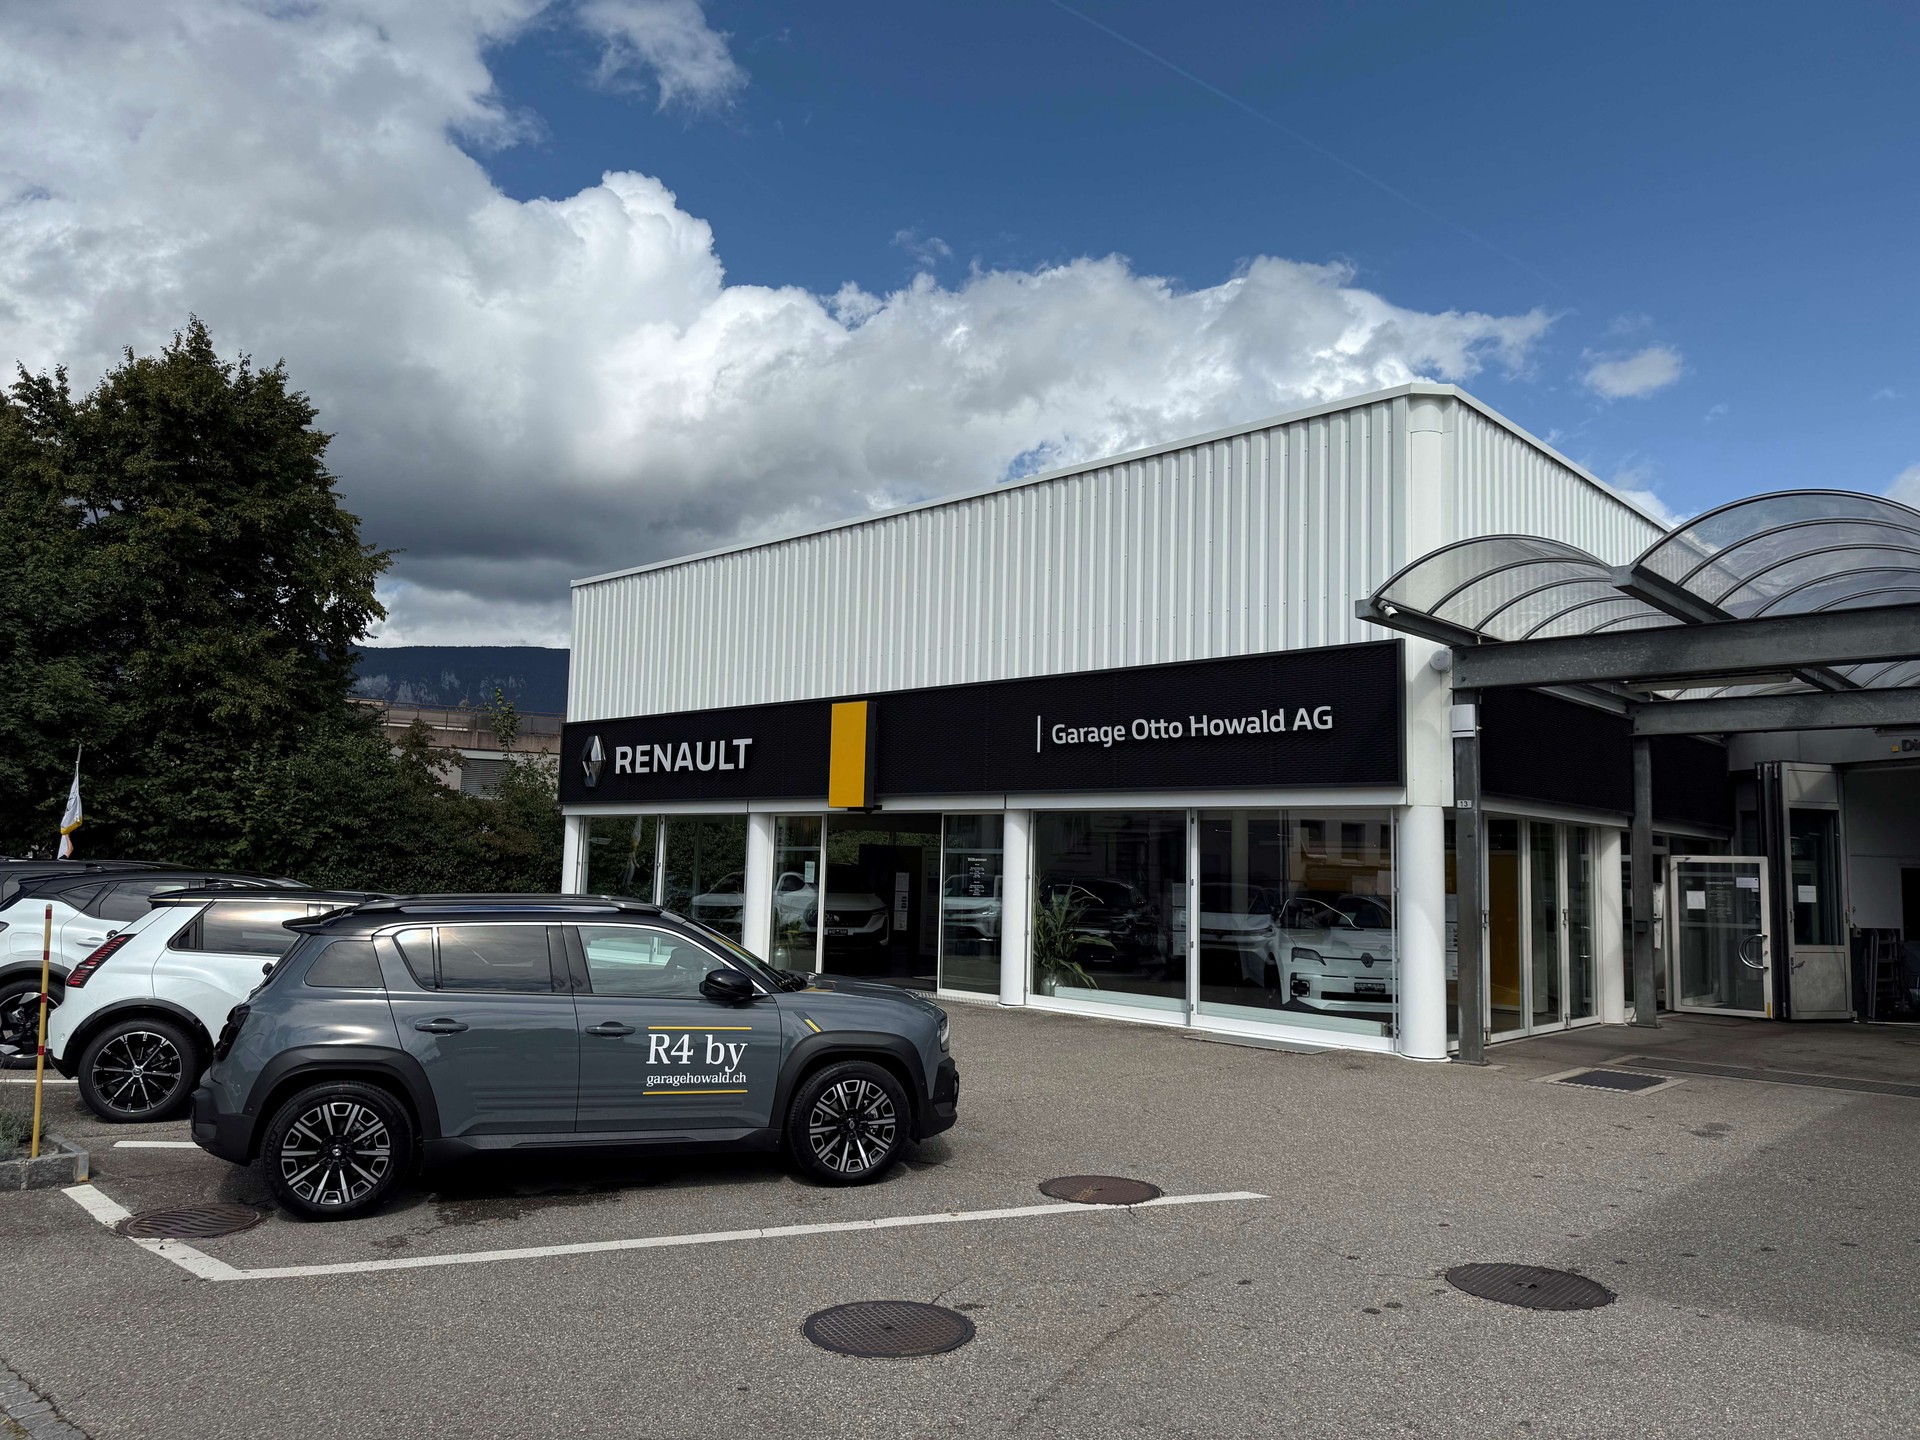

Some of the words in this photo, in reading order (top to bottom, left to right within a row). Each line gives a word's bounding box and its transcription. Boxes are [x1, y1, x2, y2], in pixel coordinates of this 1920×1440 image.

[1051, 723, 1126, 747] Garage
[1131, 717, 1183, 741] Otto
[1189, 708, 1286, 737] Howald
[1292, 705, 1333, 731] AG
[615, 738, 753, 774] RENAULT
[1901, 738, 1920, 752] Di
[646, 1033, 694, 1065] R4
[705, 1034, 748, 1073] by
[646, 1072, 747, 1087] garagehowald.ch
